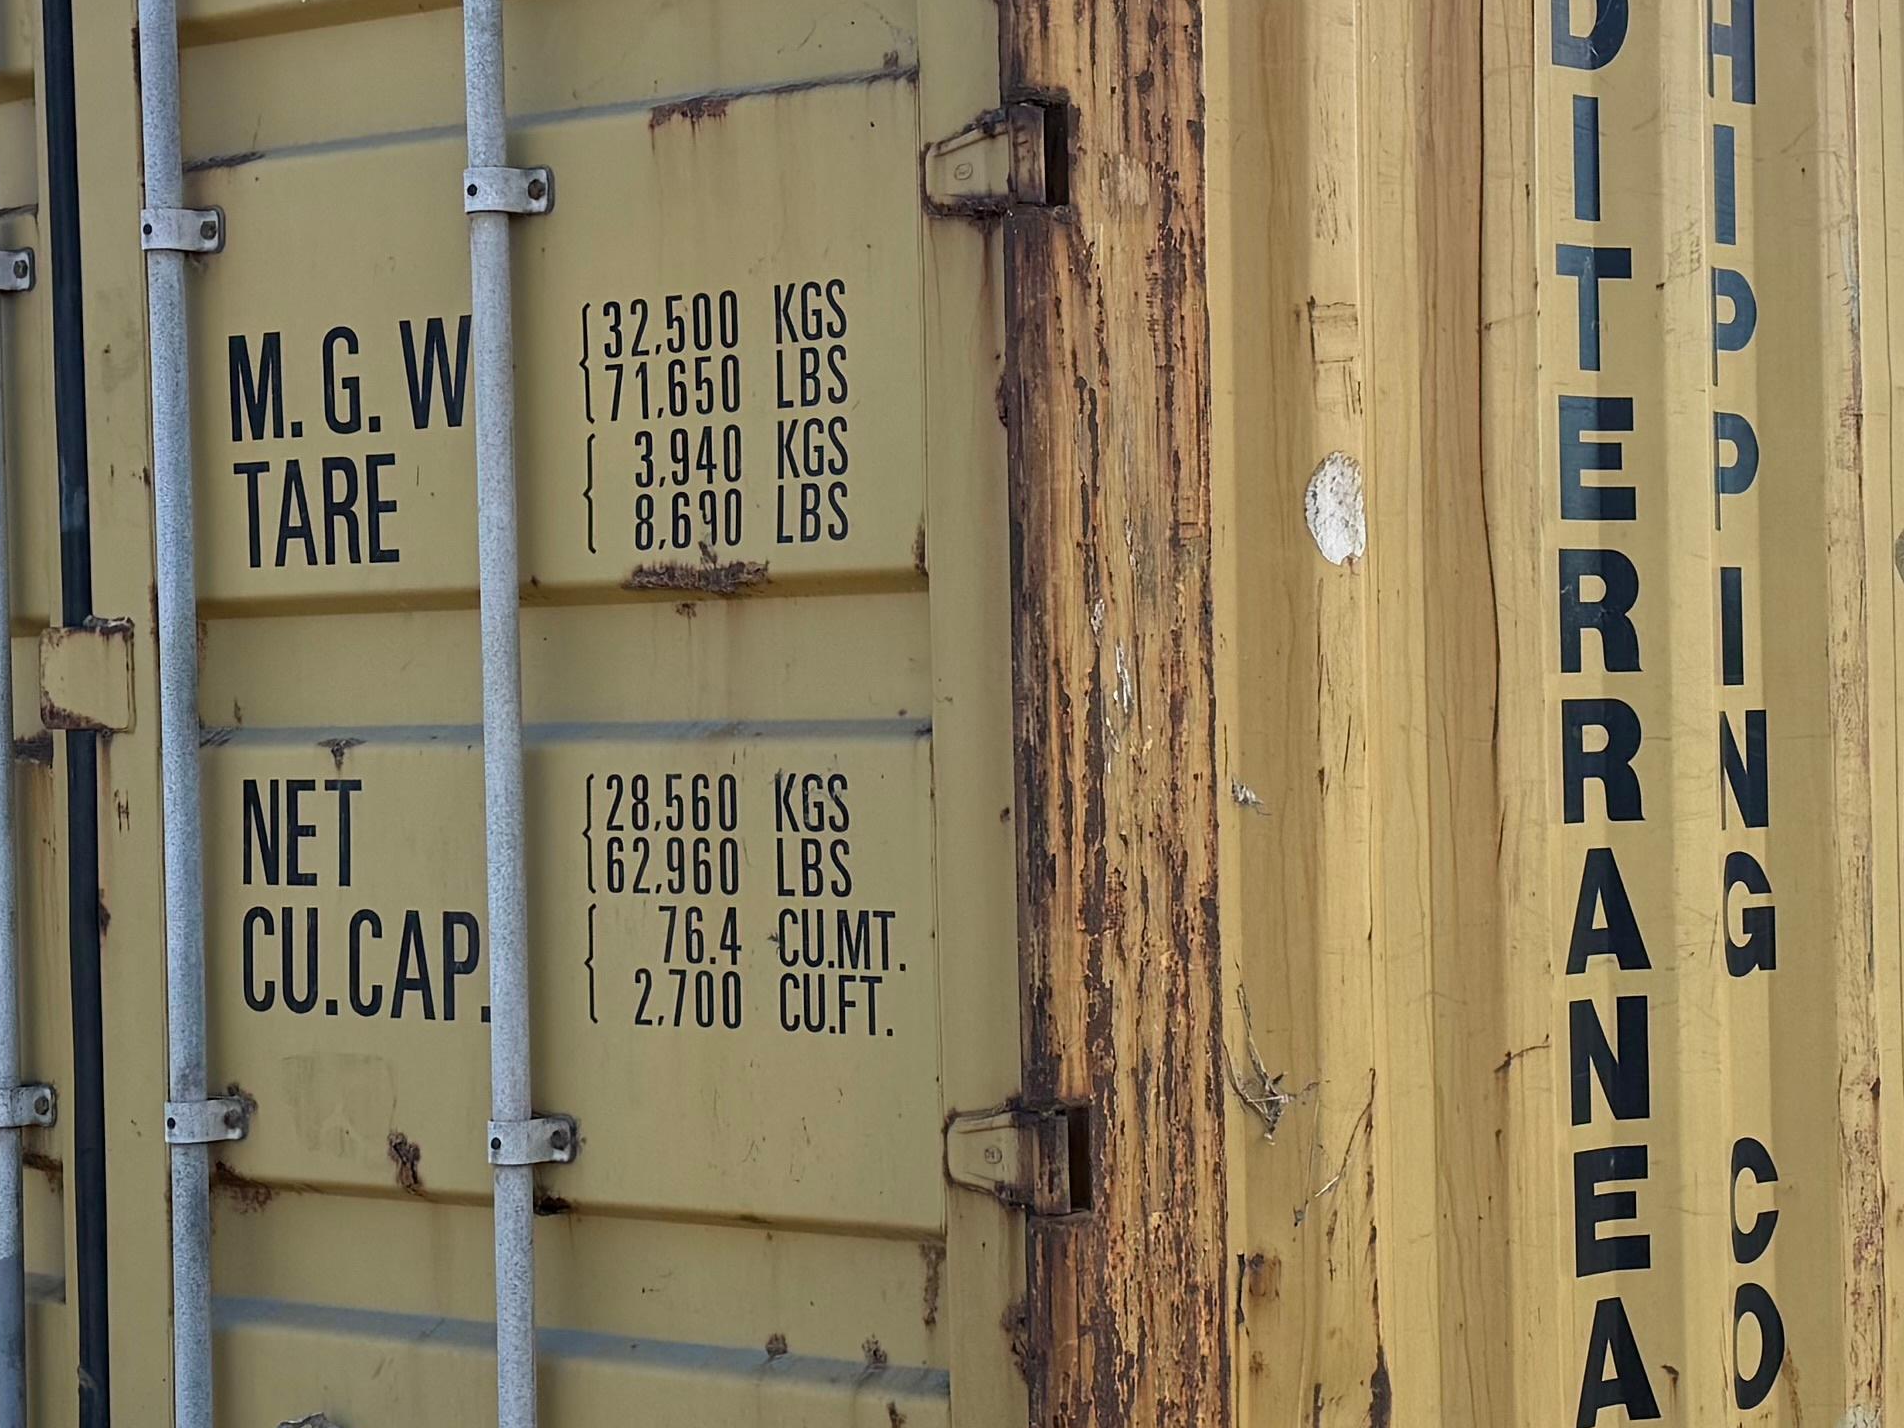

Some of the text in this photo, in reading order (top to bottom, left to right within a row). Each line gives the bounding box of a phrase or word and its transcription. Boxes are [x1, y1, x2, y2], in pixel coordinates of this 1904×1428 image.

[603, 278, 848, 359] 32,500 KGS
[604, 344, 849, 422] 71,650 LBS
[634, 415, 849, 488] 3,940 KGS
[233, 453, 400, 569] TARE
[776, 481, 849, 545] LBS
[242, 778, 363, 888] NET
[606, 773, 850, 832] 28,560 KGS
[606, 836, 852, 897] 62,960 LBS
[658, 905, 907, 972] 76.4 CU.MT.
[634, 968, 894, 1037] 2,700 CU.FT.
